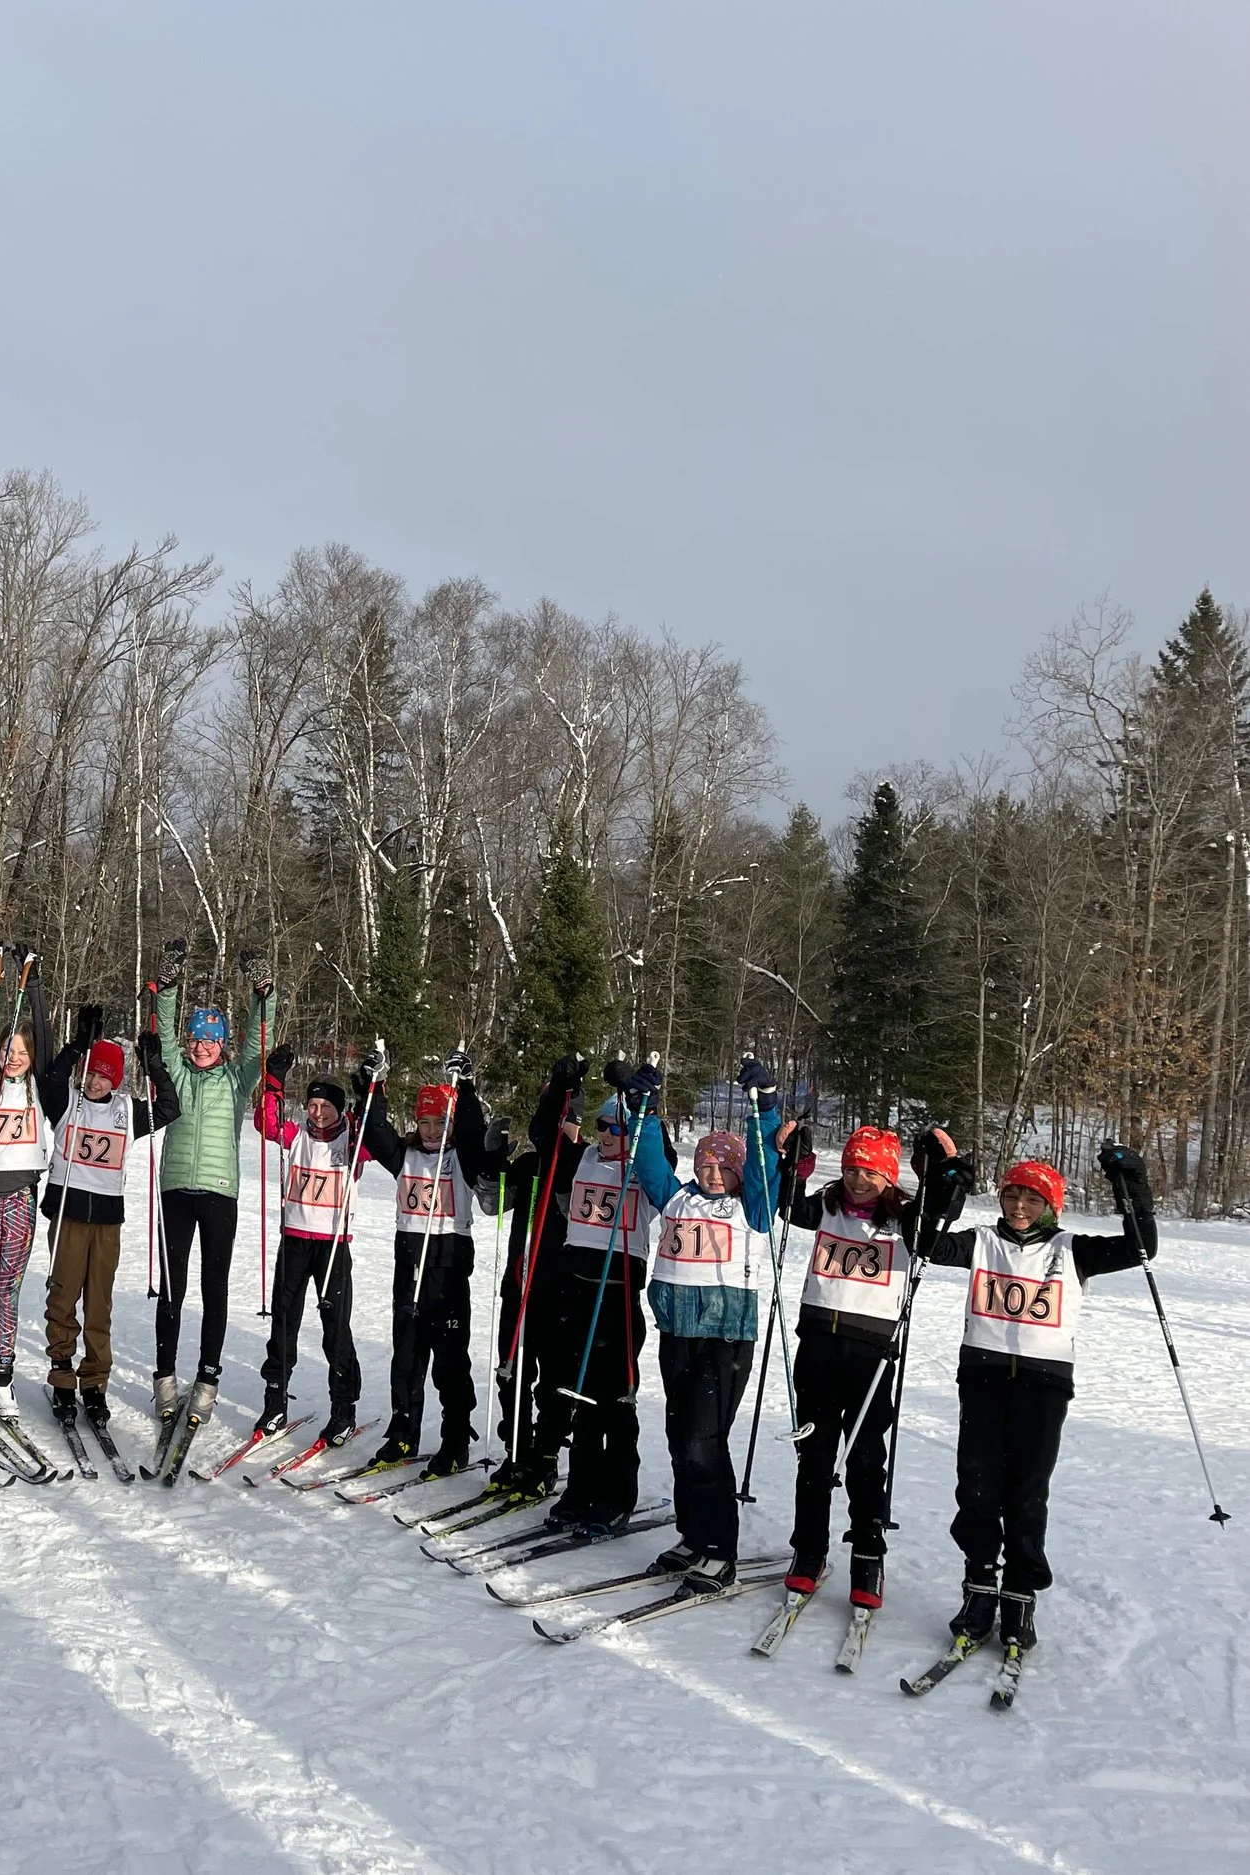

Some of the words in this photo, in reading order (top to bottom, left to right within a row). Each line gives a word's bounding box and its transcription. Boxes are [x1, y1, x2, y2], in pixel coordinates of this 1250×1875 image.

[78, 1133, 111, 1163] 52
[299, 1172, 328, 1201] 77
[406, 1182, 439, 1212] 63
[580, 1188, 617, 1222] 55
[670, 1223, 703, 1256] 51
[822, 1242, 881, 1278] 103
[984, 1278, 1052, 1321] 105
[446, 1319, 459, 1329] 12
